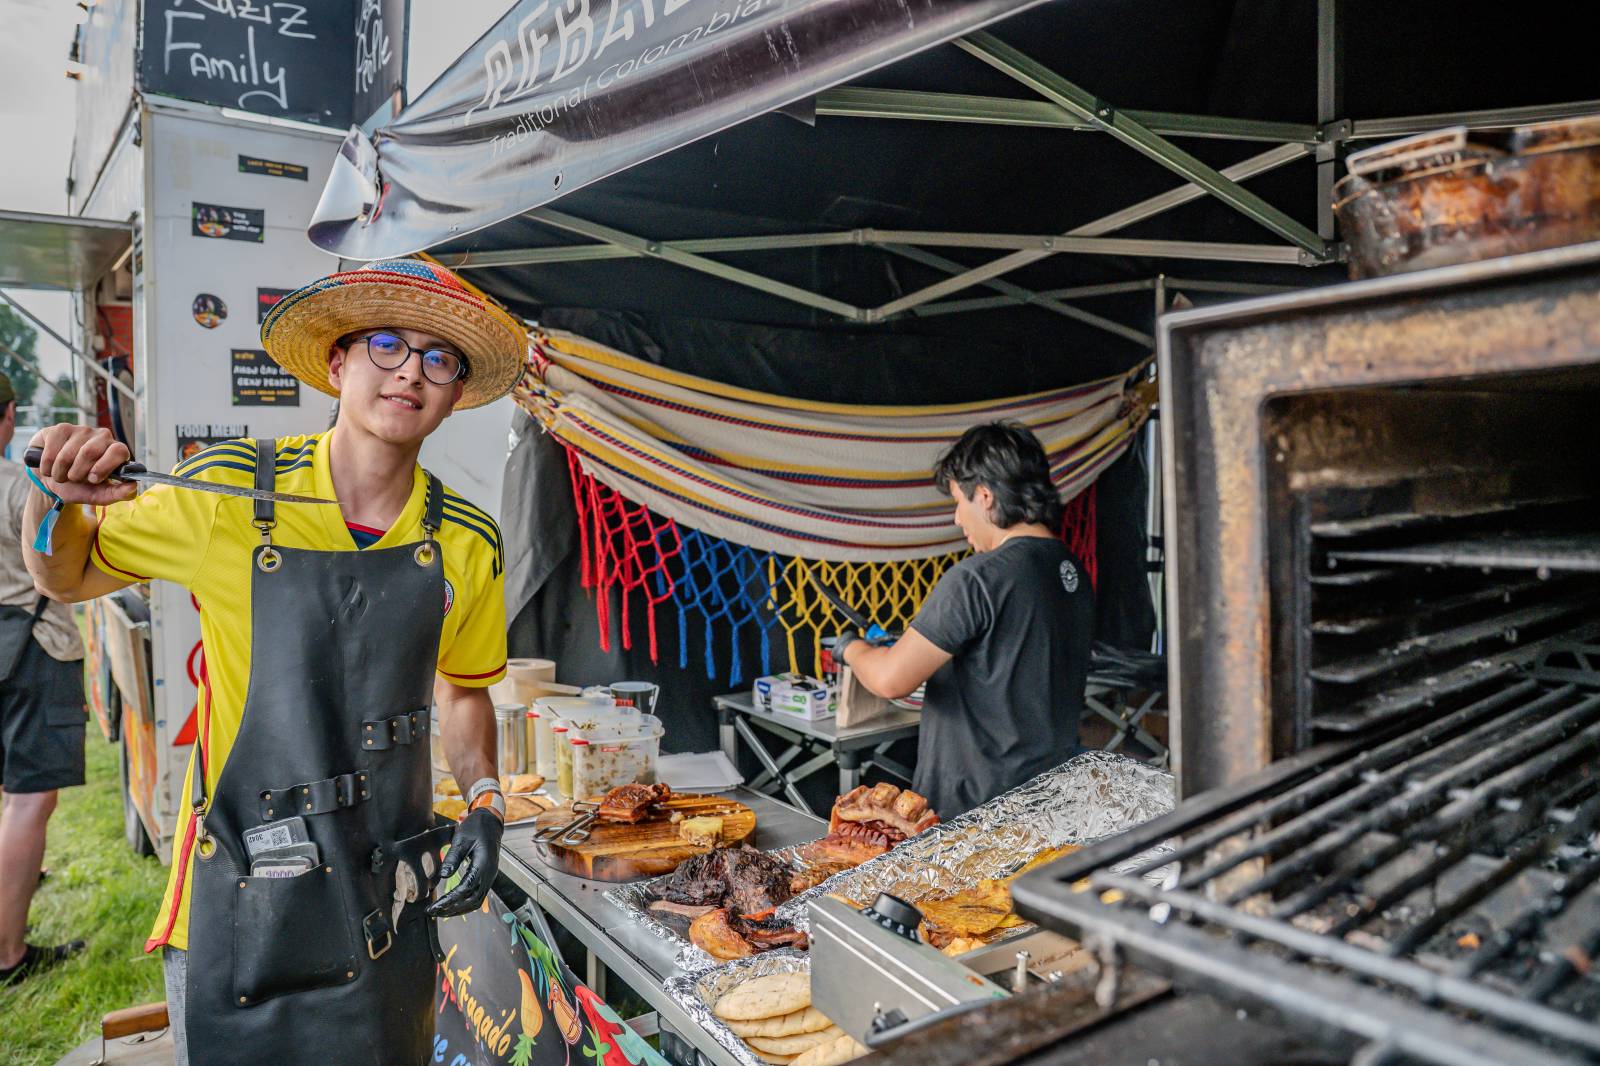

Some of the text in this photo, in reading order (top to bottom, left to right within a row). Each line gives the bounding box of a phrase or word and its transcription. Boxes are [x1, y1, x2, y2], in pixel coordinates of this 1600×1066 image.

[489, 0, 770, 158] Traditional Colombia
[177, 424, 209, 438] FOOD
